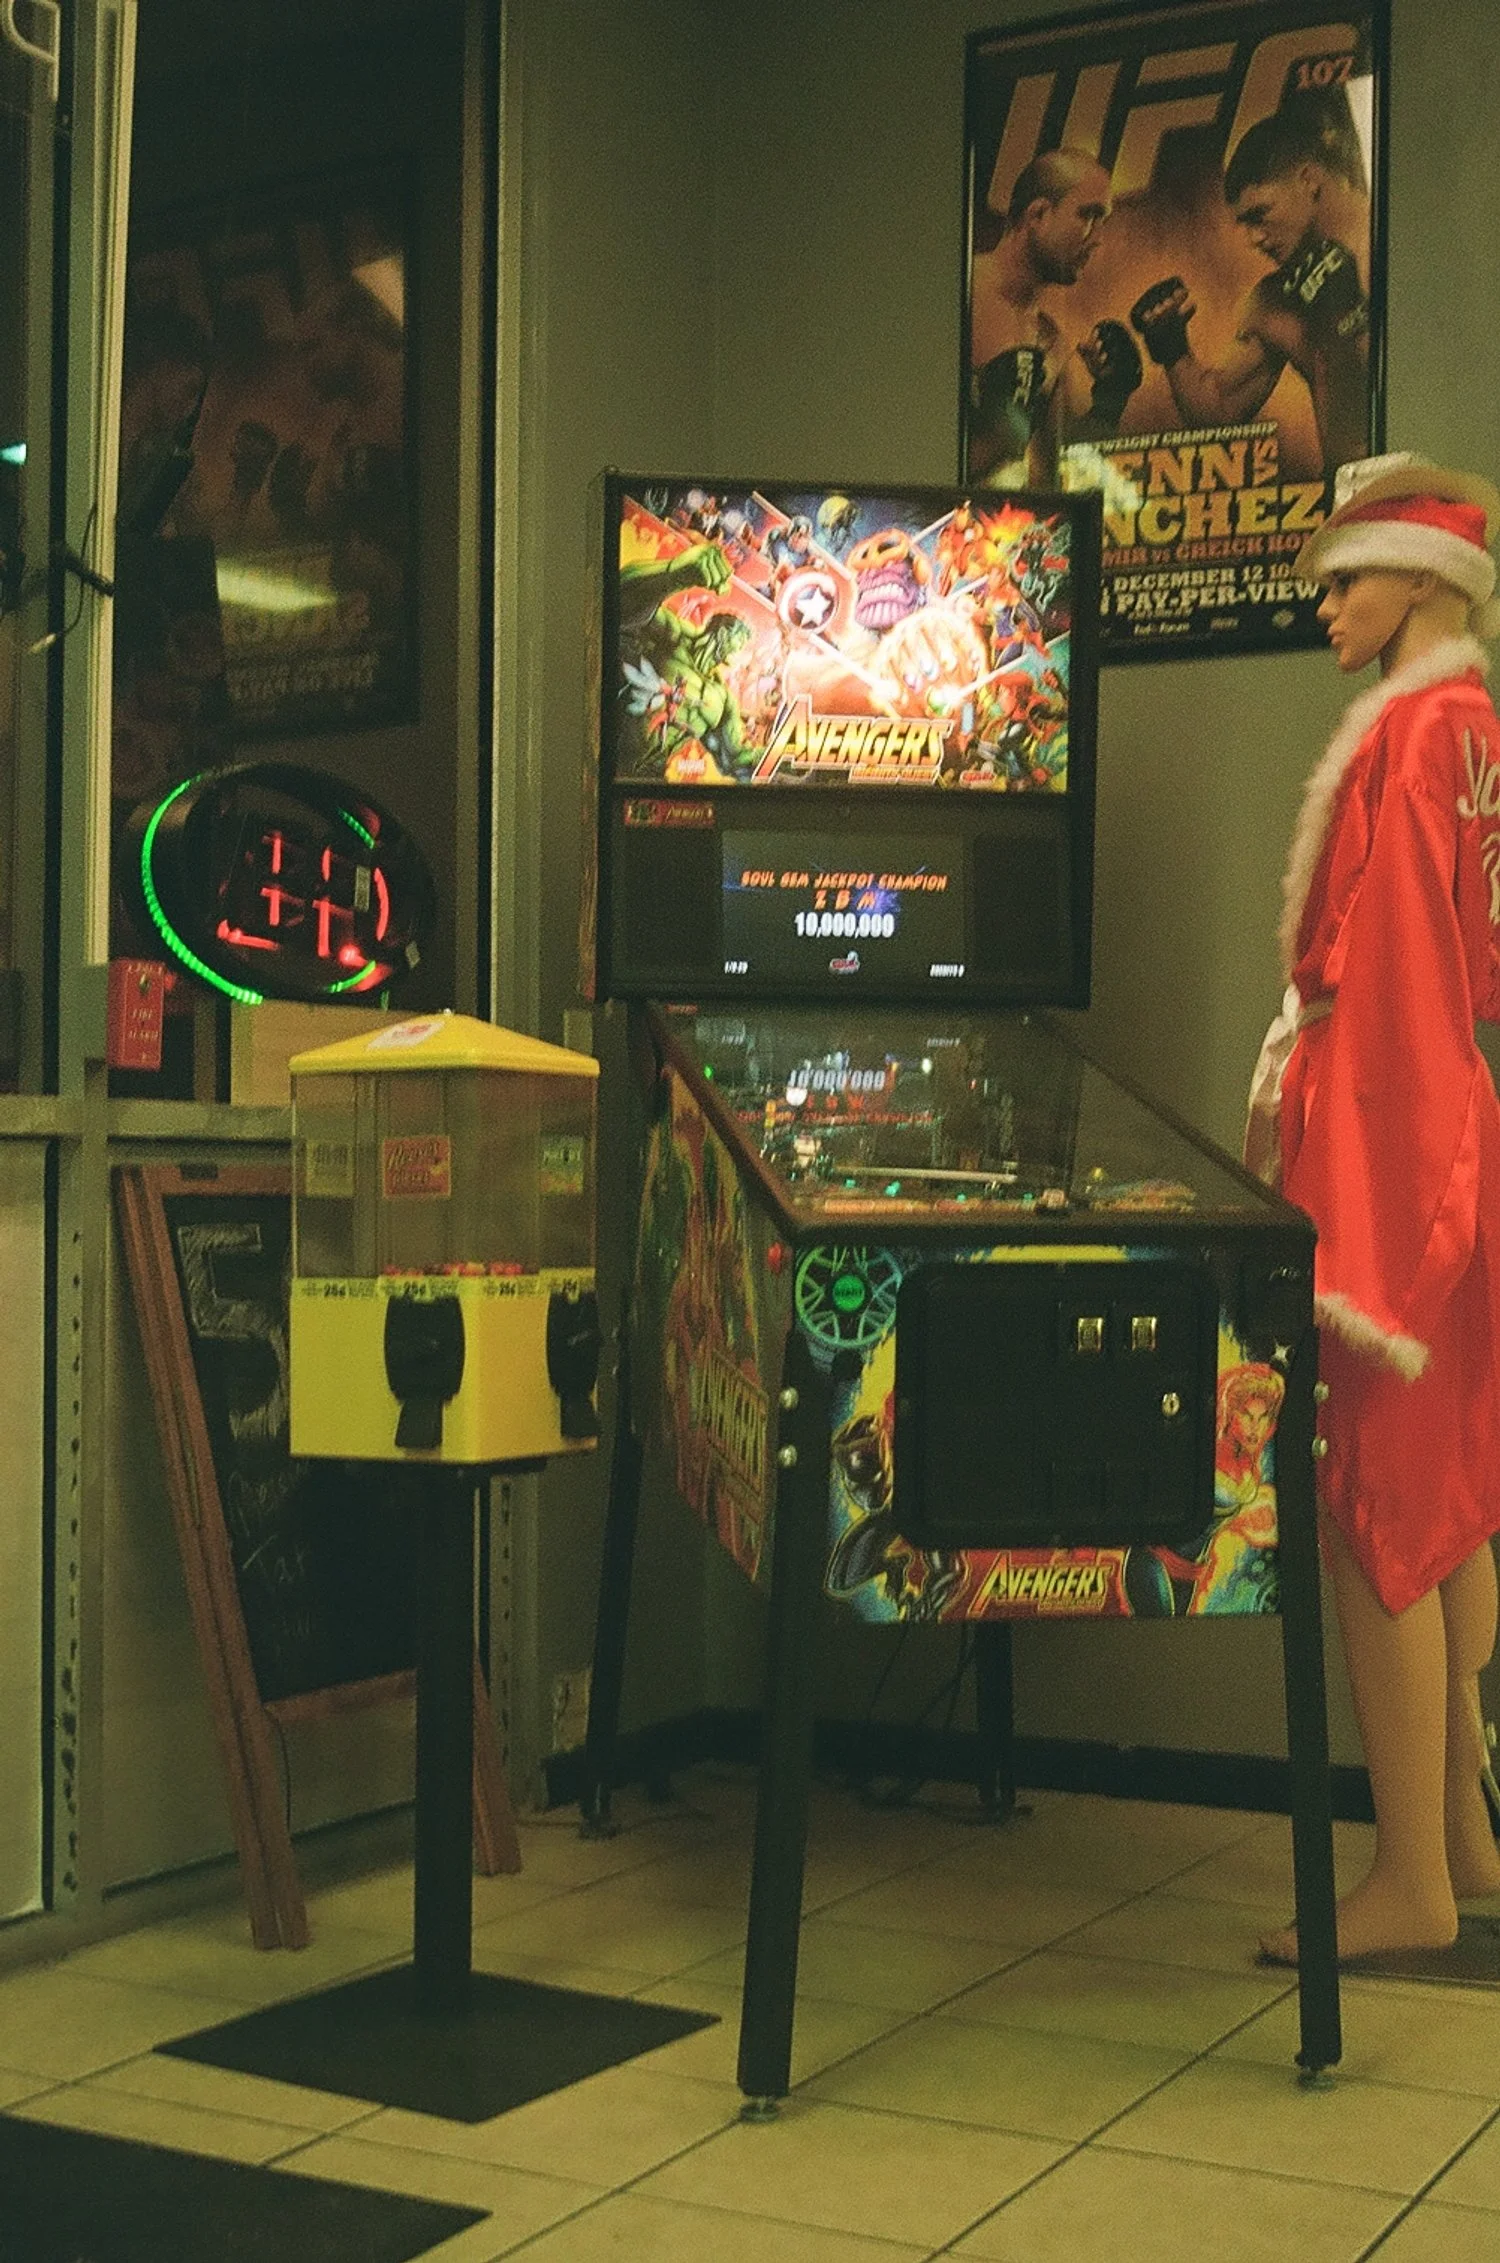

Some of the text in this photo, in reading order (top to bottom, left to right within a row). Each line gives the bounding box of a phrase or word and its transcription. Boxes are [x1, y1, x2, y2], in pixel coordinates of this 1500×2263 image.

[1294, 56, 1355, 91] 107
[1161, 421, 1278, 445] CHAMPIONSHIP
[1114, 567, 1237, 593] DECEMBER
[1241, 565, 1265, 583] 12
[1115, 580, 1320, 616] PAY-PER-VIEW
[754, 697, 953, 781] AVENGERS
[741, 871, 949, 891] SOUL GEM JACKPOT CHAMPION
[794, 912, 895, 939] 10,000,000
[967, 1551, 1115, 1617] AVENGERS
